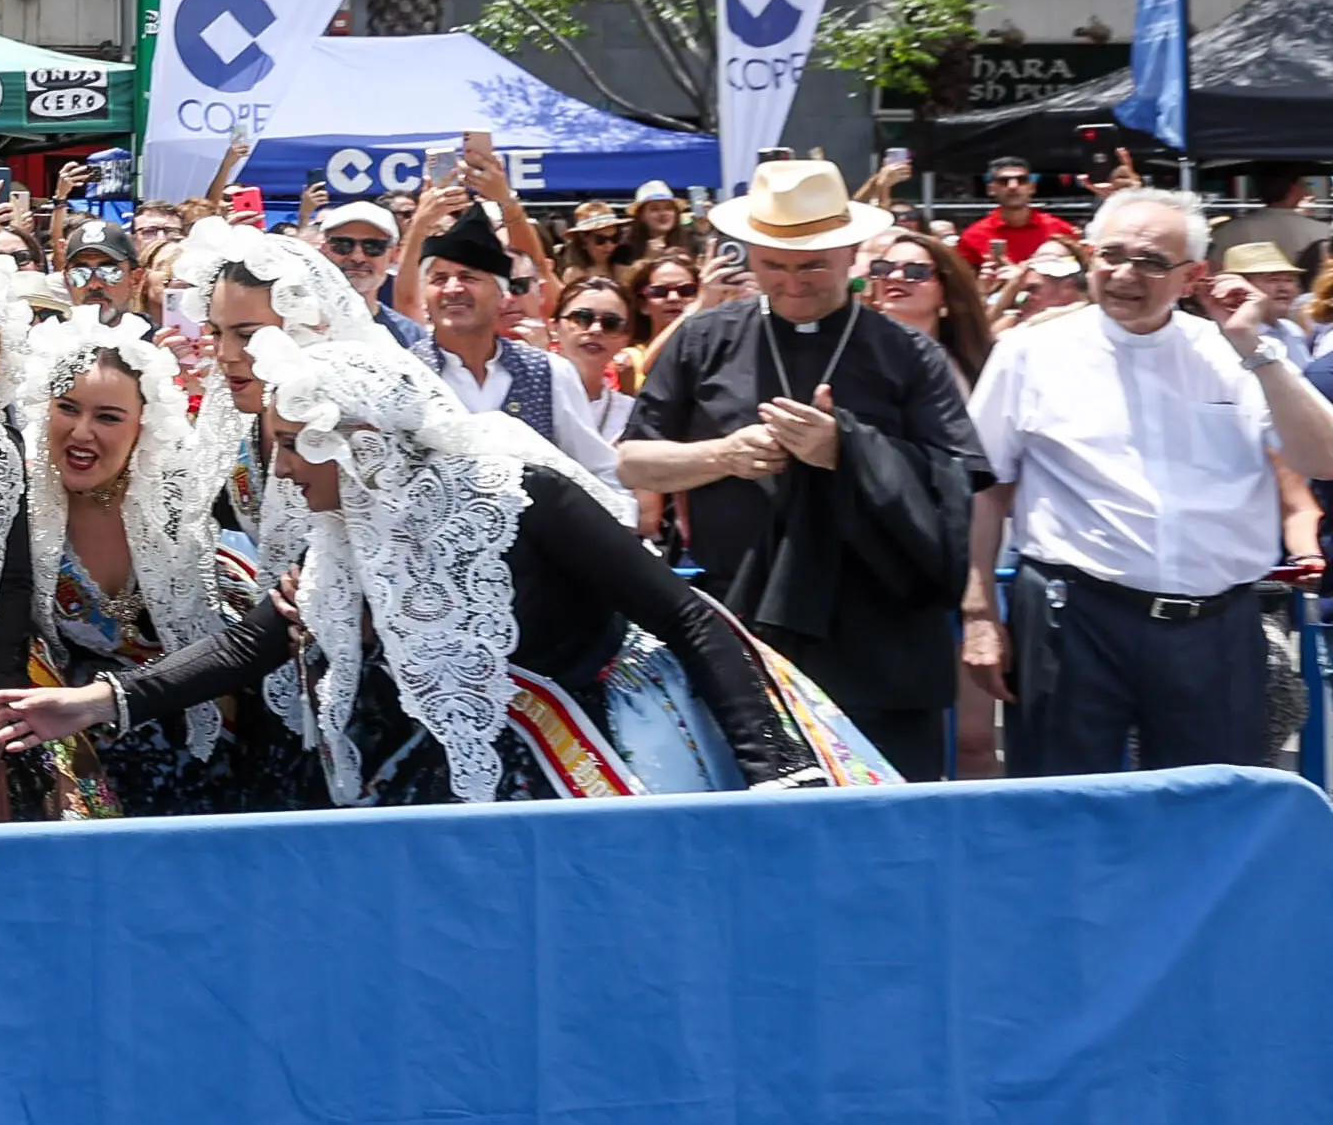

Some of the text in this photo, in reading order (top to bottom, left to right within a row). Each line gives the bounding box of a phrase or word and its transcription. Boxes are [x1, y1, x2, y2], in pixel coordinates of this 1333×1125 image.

[36, 69, 97, 83] ONDA
[42, 94, 95, 111] CERO
[177, 98, 272, 134] COPE
[379, 148, 546, 194] CE
